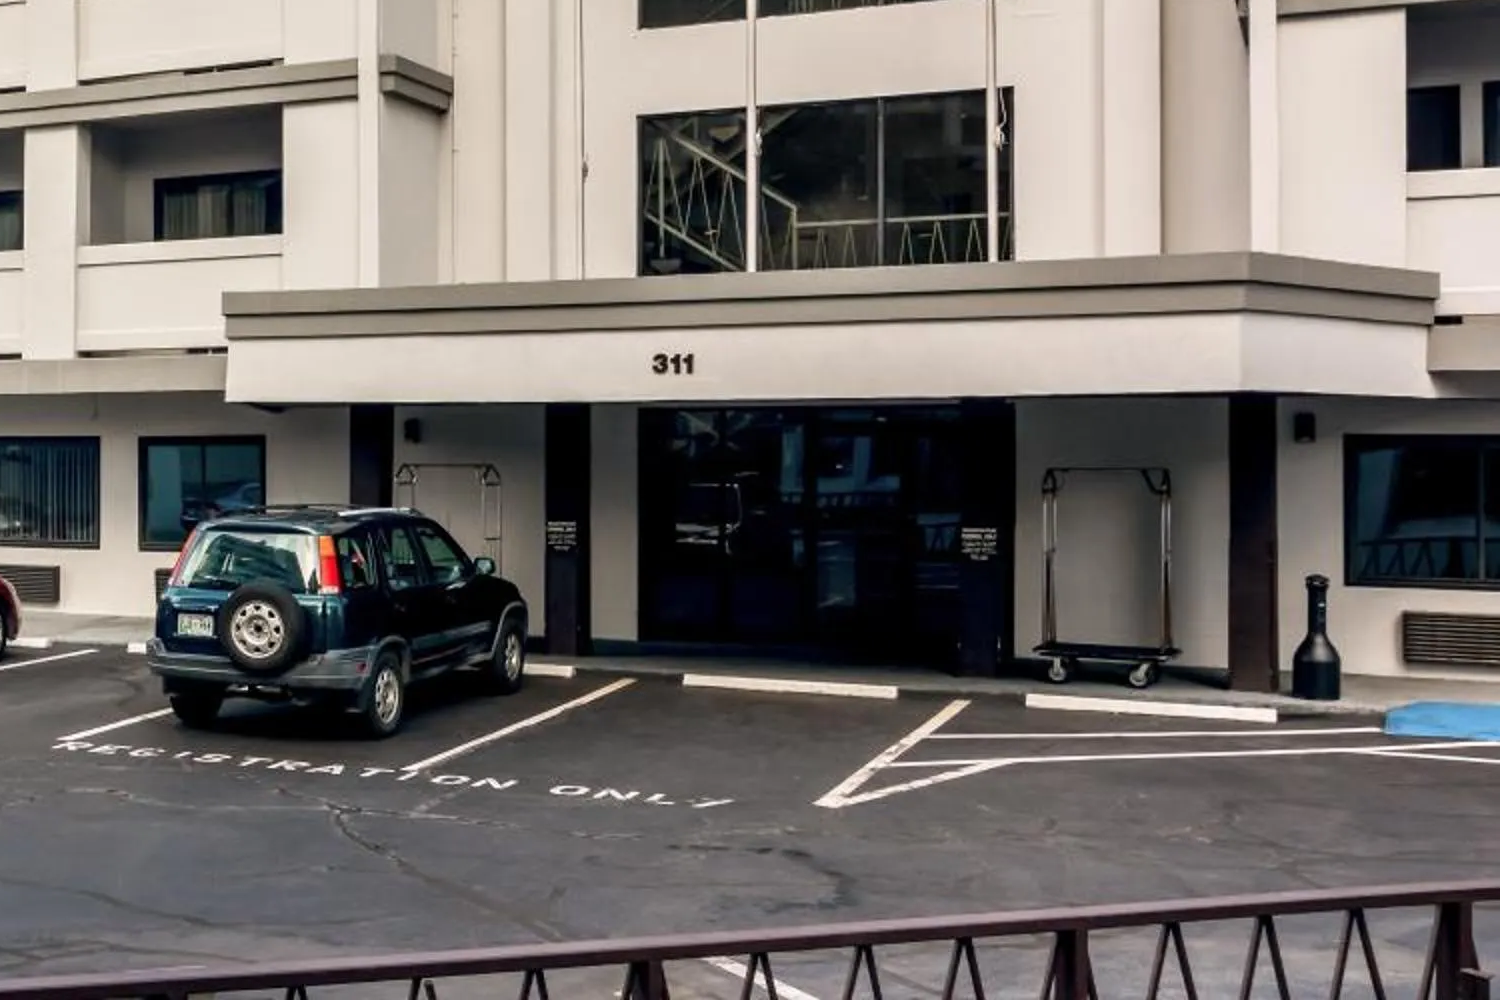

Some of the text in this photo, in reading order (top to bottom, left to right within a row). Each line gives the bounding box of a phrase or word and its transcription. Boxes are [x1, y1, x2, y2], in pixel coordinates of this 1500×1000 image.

[652, 353, 695, 375] 311
[52, 741, 735, 808] REGISTRATION ONLY
